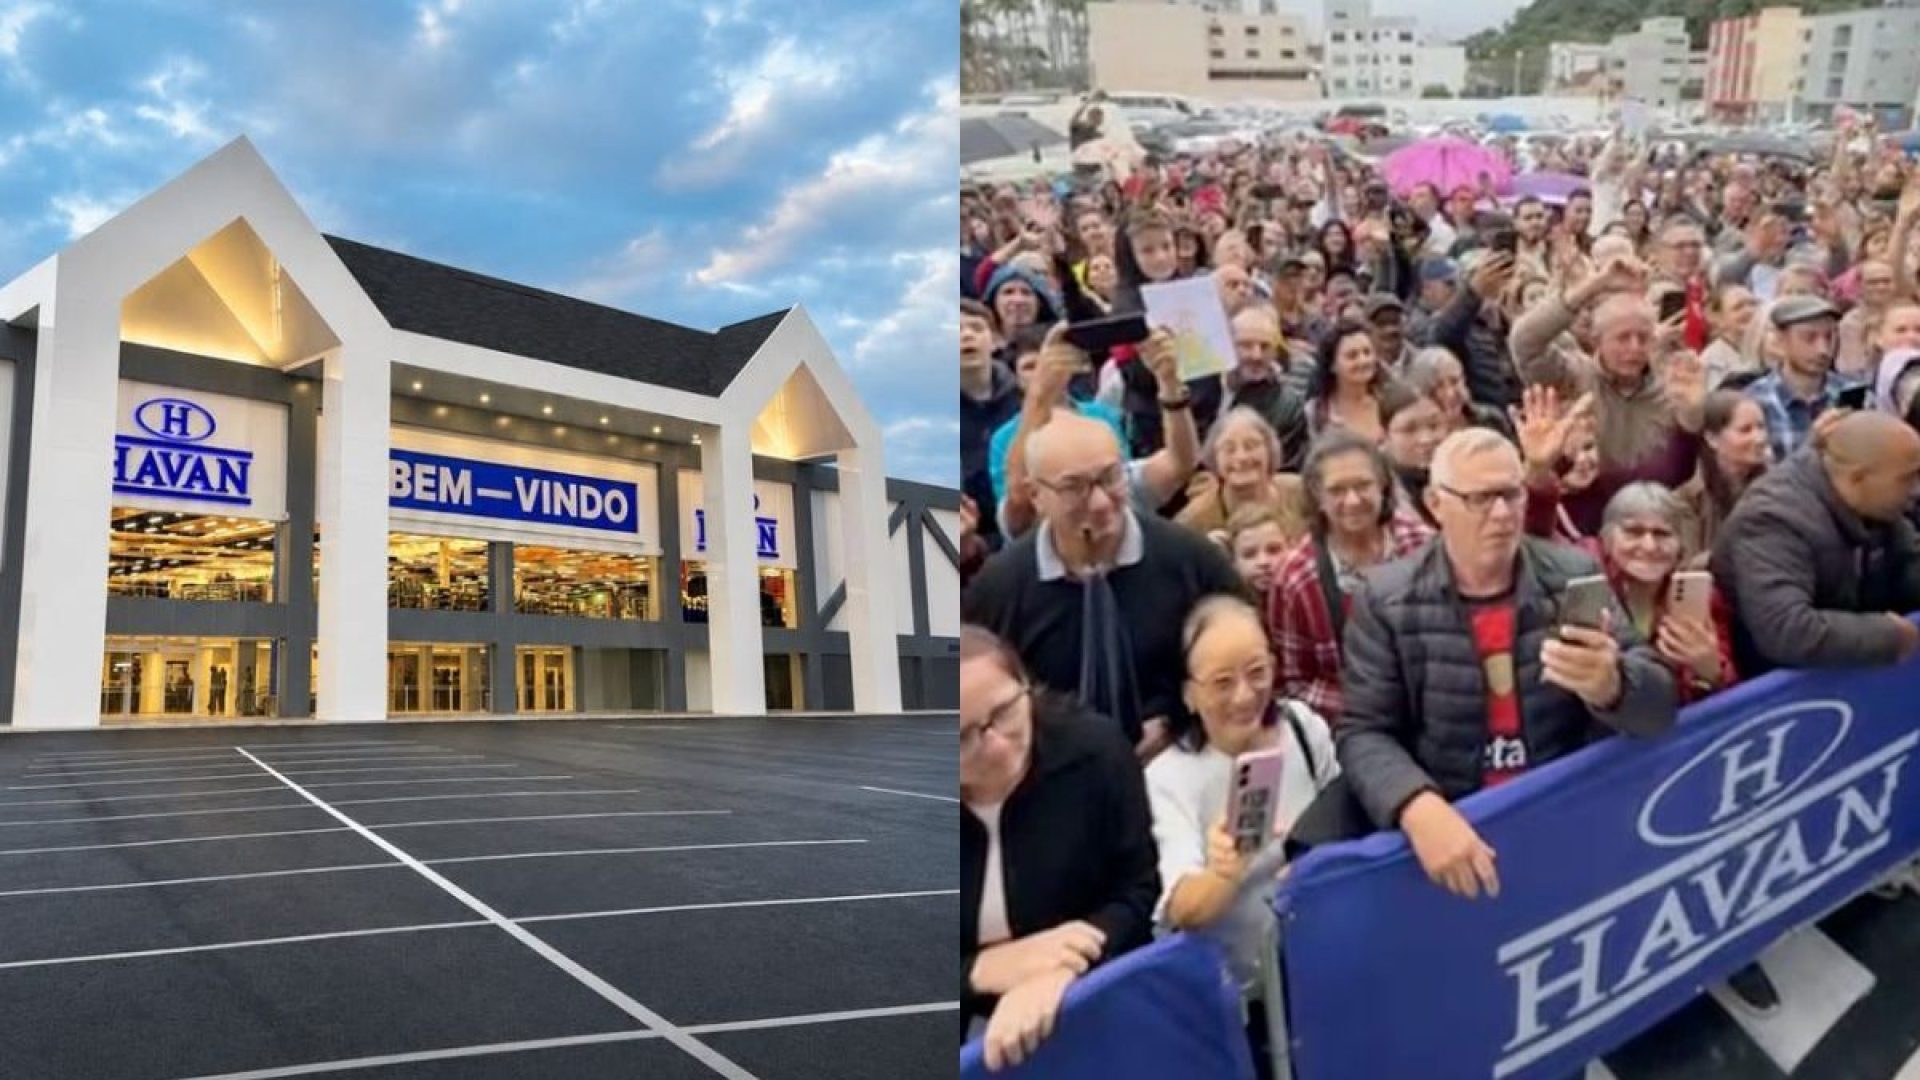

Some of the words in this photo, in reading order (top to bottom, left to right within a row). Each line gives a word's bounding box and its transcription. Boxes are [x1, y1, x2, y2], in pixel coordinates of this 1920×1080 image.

[161, 403, 192, 437] H
[1710, 719, 1797, 822] H
[1502, 754, 1909, 1053] HAVAN
